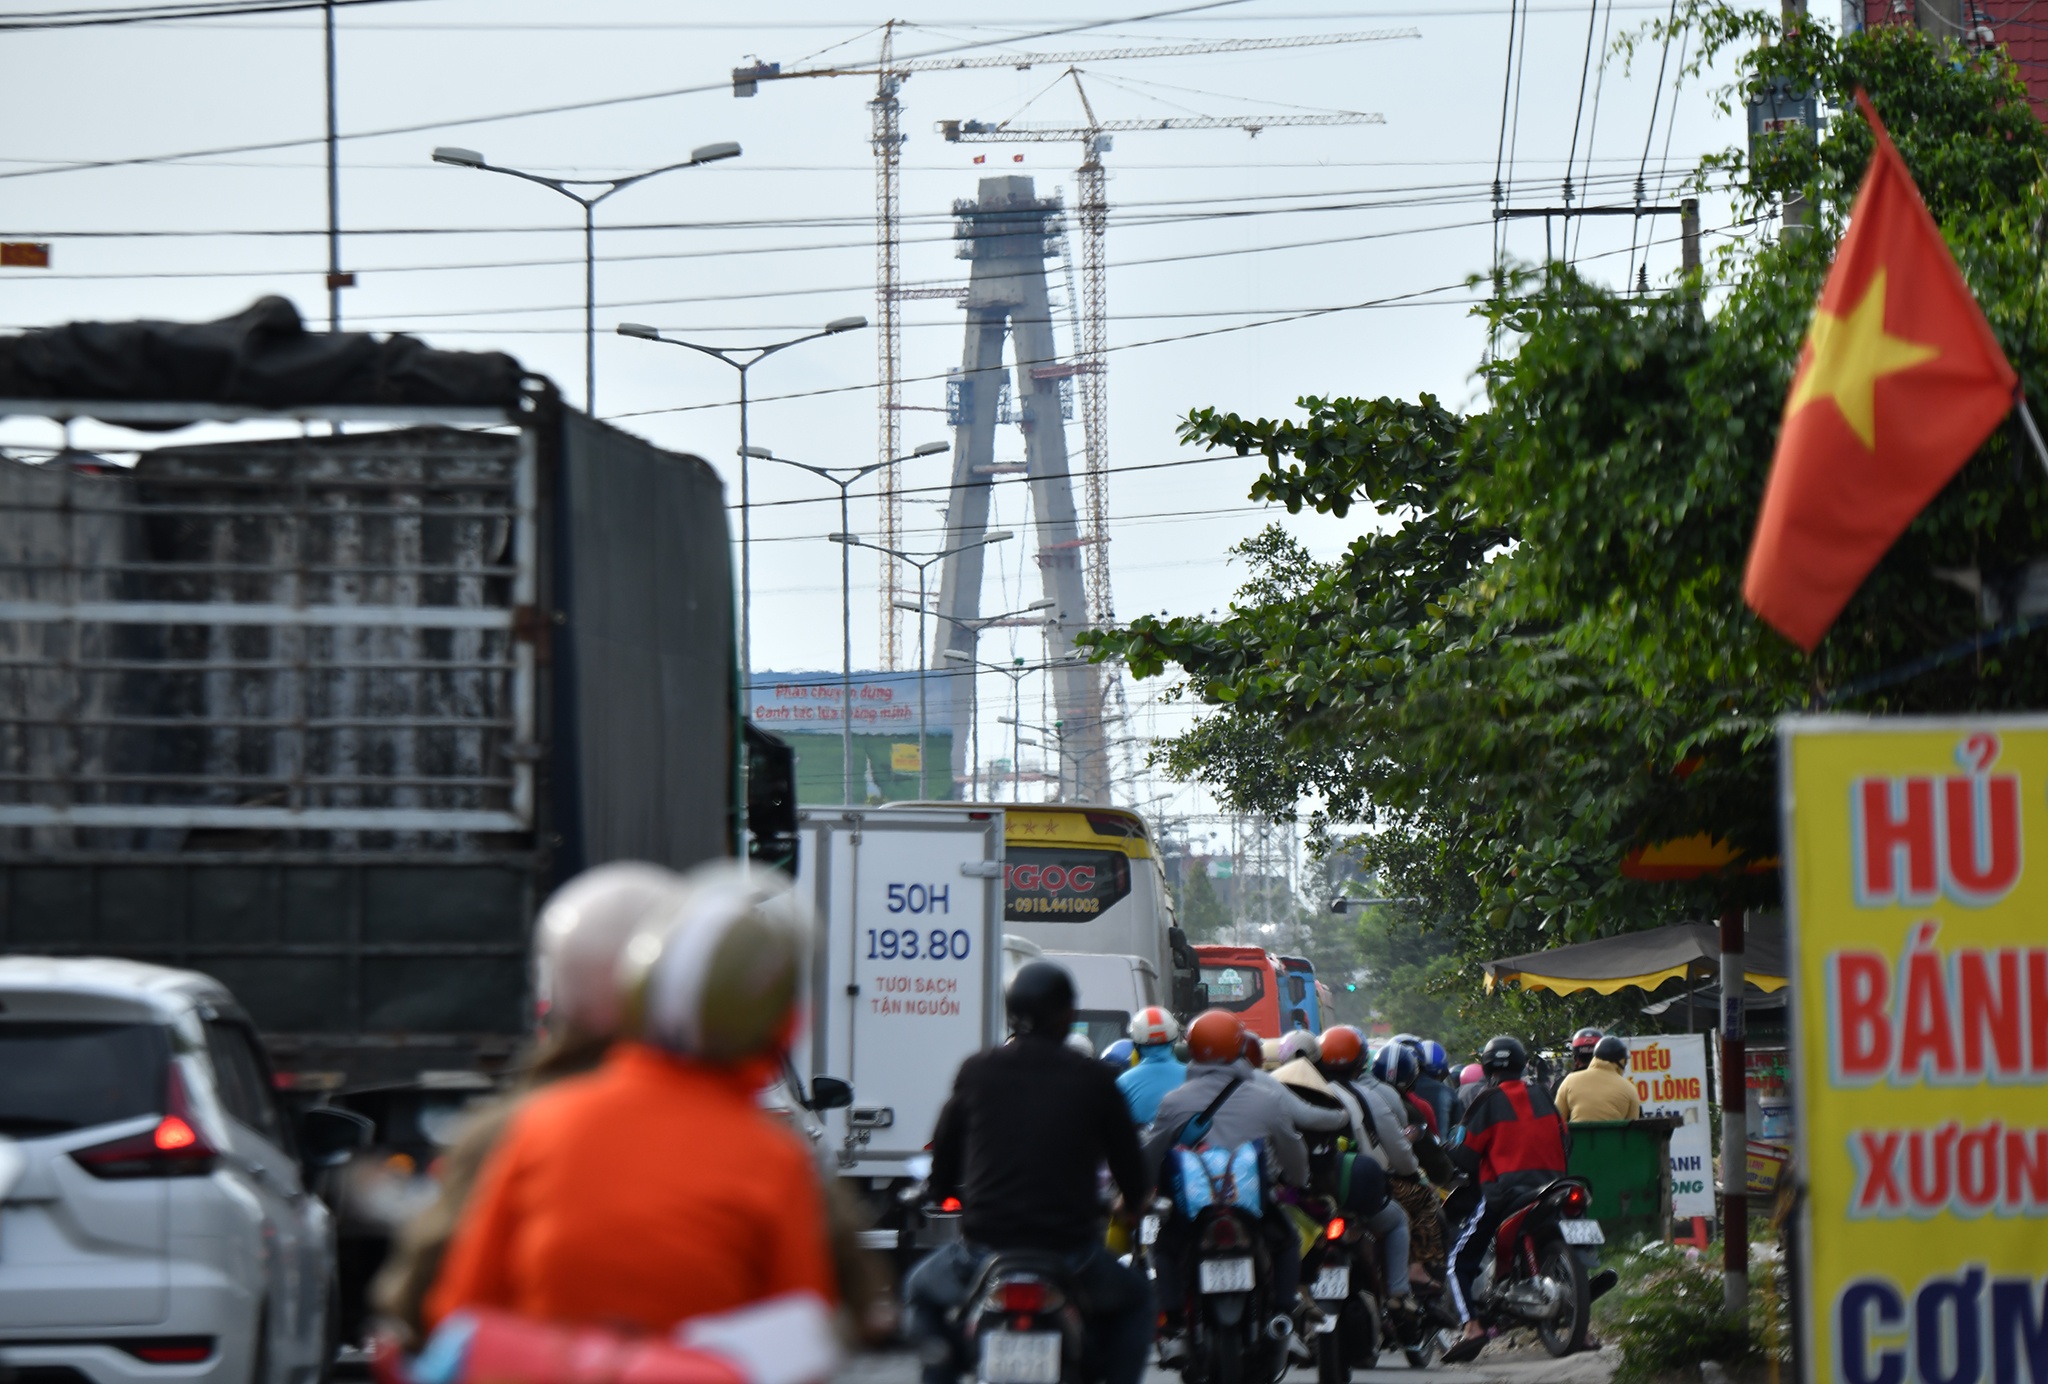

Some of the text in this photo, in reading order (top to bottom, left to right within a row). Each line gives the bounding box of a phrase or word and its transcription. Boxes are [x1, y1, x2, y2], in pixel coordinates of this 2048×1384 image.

[810, 685, 857, 702] chuyn
[755, 705, 789, 719] Canh
[1857, 731, 2020, 900] HỦ
[887, 883, 949, 914] 50H
[867, 929, 971, 960] 193.80
[876, 976, 911, 992] TƯƠI
[1630, 1042, 1671, 1073] TIẾU
[1653, 1074, 1701, 1102] LÒNG
